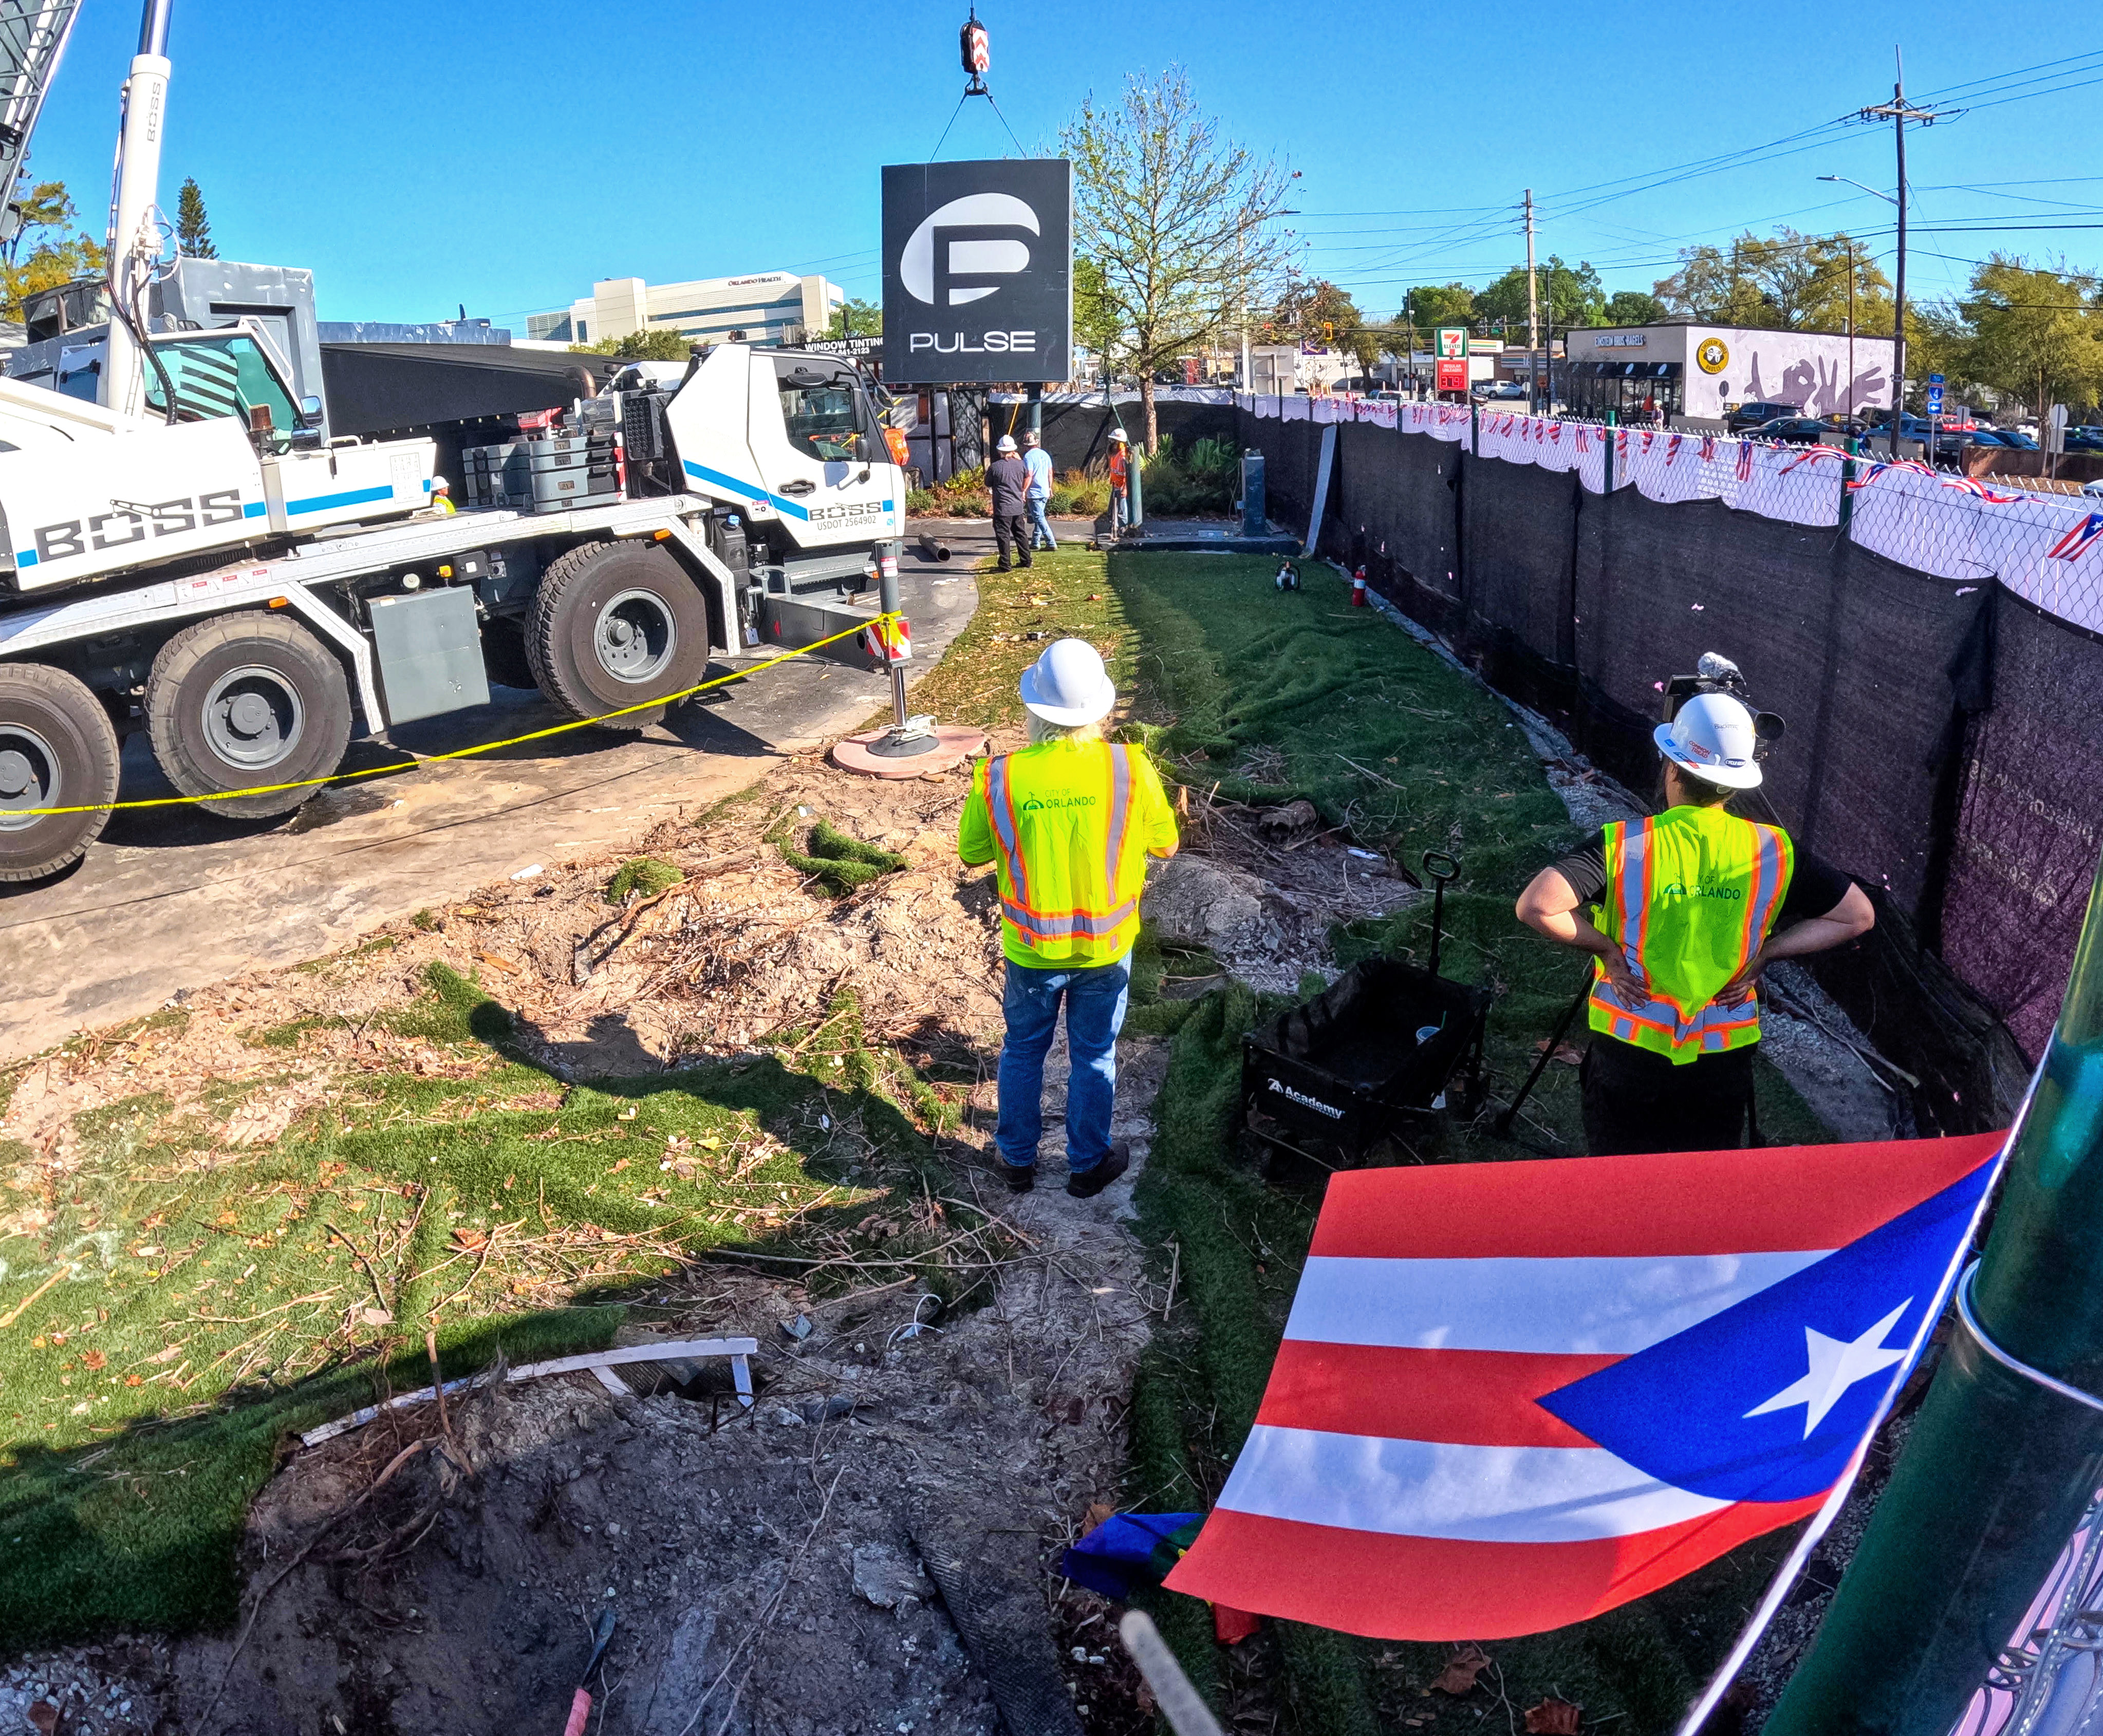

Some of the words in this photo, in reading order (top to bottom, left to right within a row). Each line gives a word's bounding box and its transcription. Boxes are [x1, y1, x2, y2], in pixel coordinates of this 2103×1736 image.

[147, 82, 160, 142] BOSS
[805, 340, 846, 351] WINDOW
[910, 331, 1036, 353] PULSE
[1933, 388, 1939, 399] 4
[809, 501, 881, 521] BOSS
[34, 489, 243, 563] BOSS
[817, 521, 842, 531] USDOT
[845, 516, 876, 527] 2564902
[1689, 740, 1712, 755] COMMON
[1046, 796, 1096, 809] ORLANDO
[1704, 875, 1715, 884] OF
[1689, 885, 1741, 900] ORLANDO
[1286, 1086, 1343, 1119] Academy
